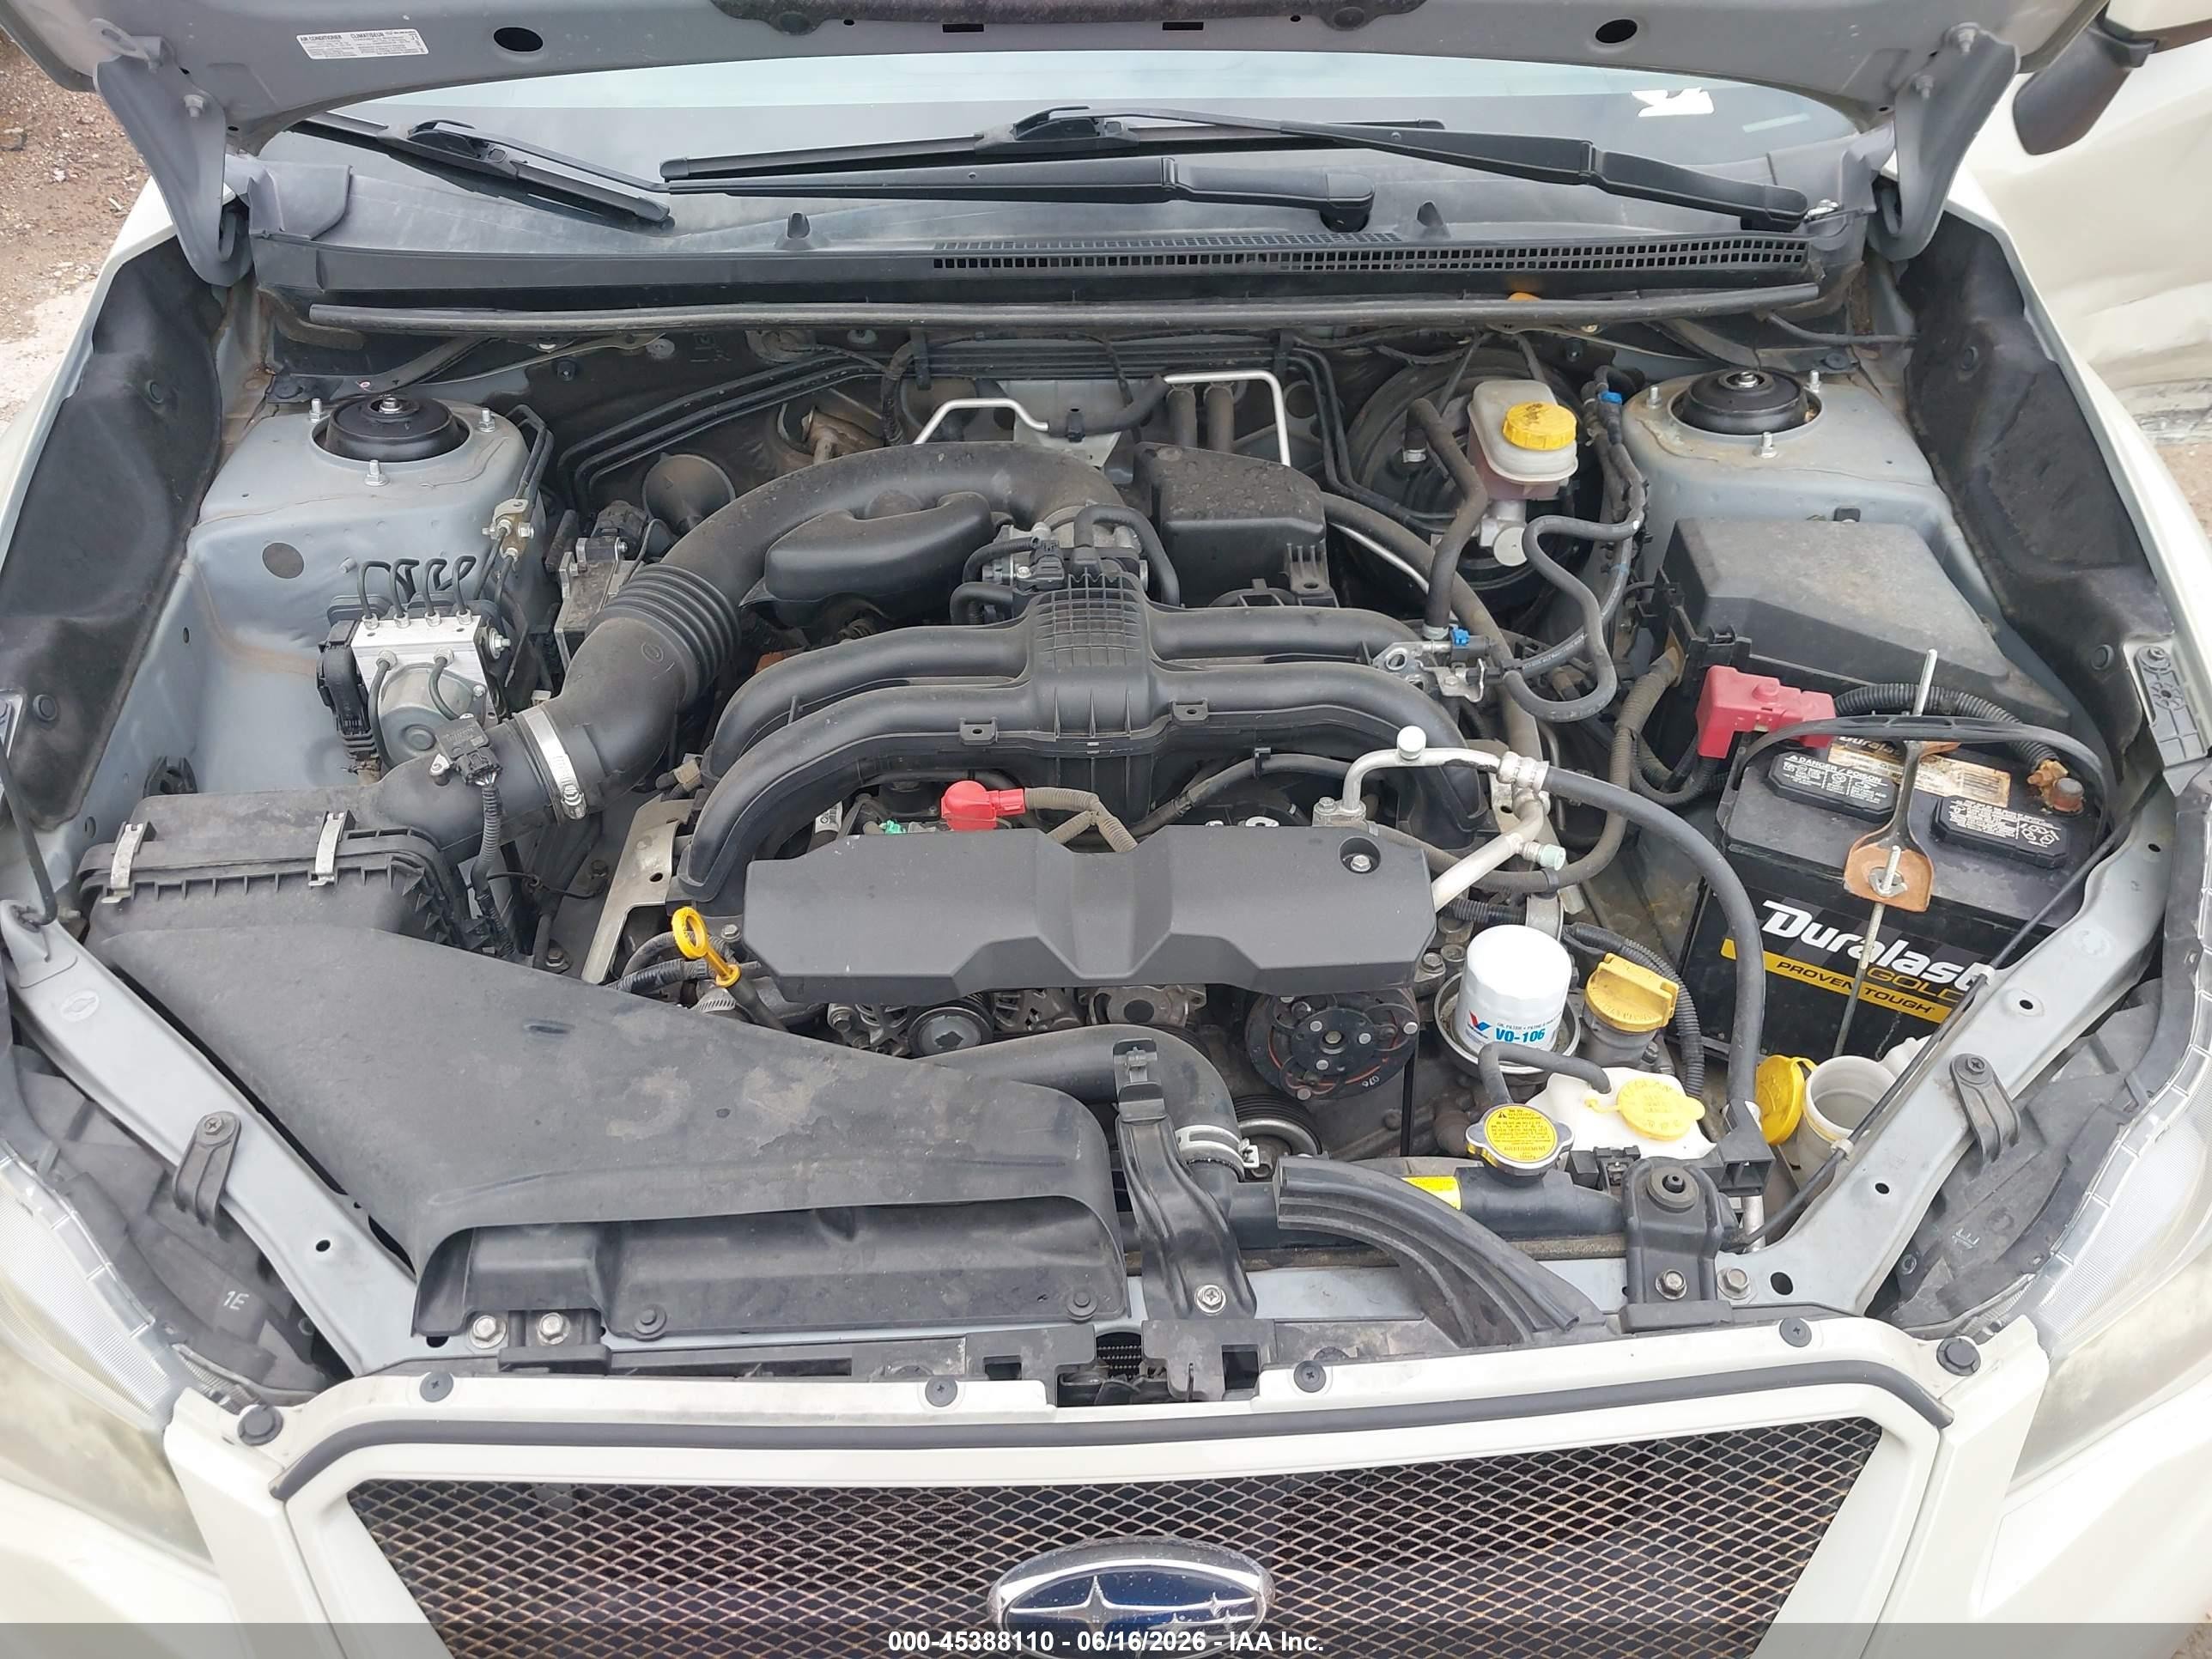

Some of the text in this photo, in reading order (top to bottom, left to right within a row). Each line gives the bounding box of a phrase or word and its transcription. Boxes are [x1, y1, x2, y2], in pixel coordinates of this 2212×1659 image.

[1799, 757, 1838, 772] DANGER
[1847, 769, 1883, 783] POISON
[1762, 900, 1977, 992] Duralast
[1776, 961, 1933, 1013] PROVEN TOUGH
[1496, 1028, 1546, 1043] VO-106
[223, 1291, 250, 1310] 1E
